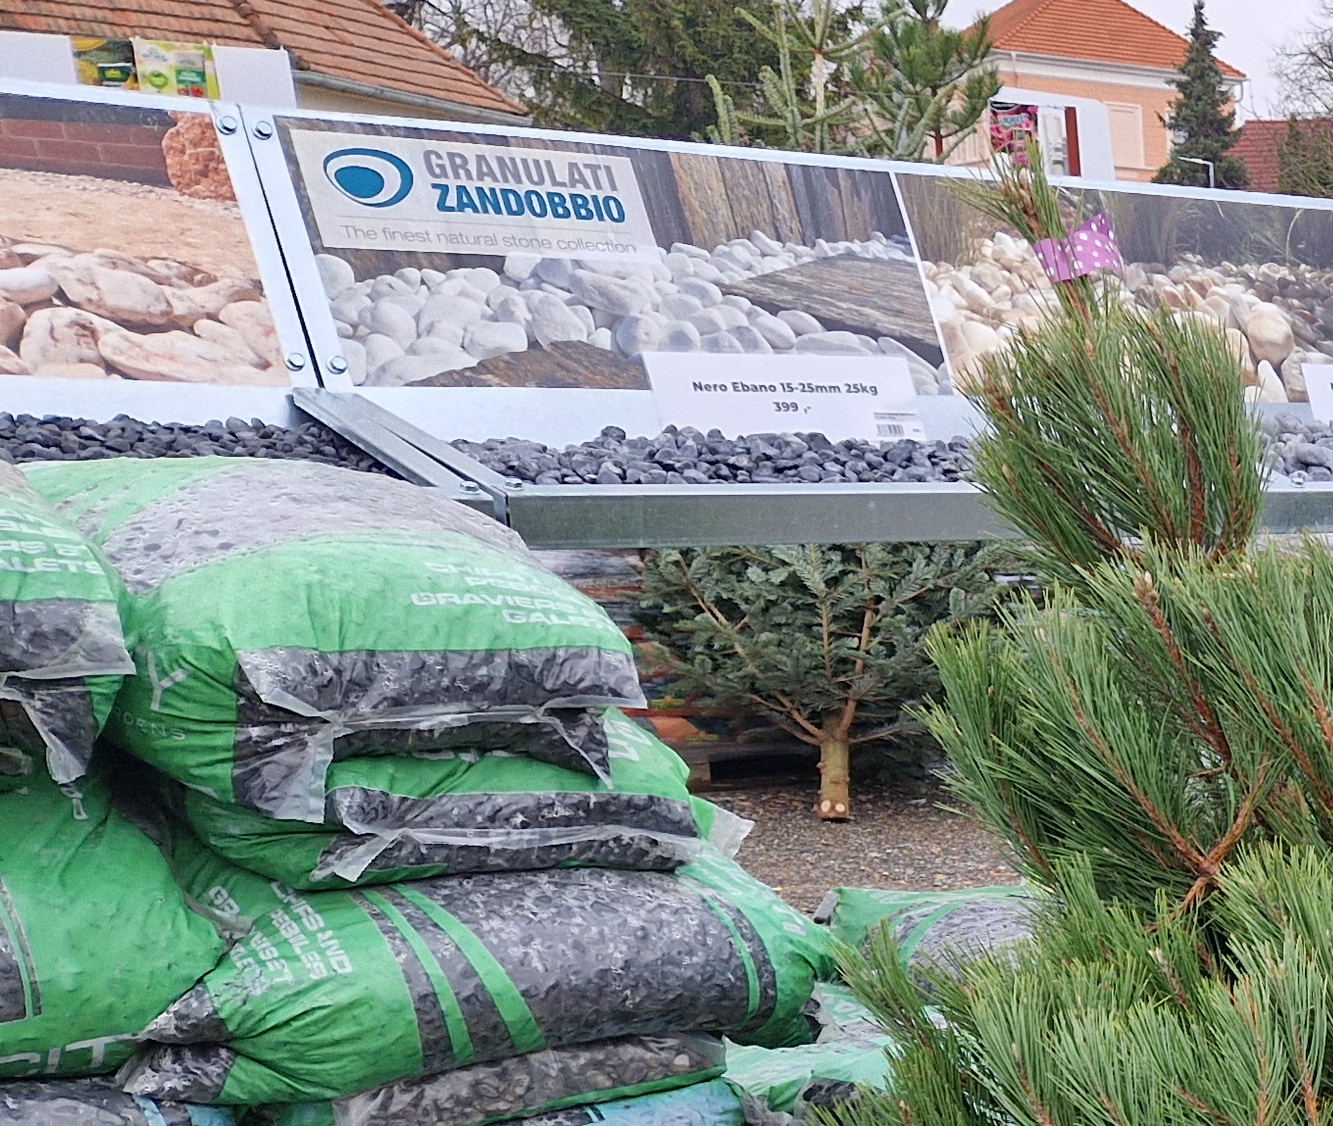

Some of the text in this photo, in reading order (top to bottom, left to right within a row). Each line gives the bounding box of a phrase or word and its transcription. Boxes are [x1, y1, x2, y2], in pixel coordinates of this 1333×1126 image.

[423, 150, 618, 191] GRANULATI
[431, 183, 626, 223] ZANDOBBIO
[340, 224, 637, 254] The finest natural stone collection
[692, 381, 878, 396] Nero Ebano 15-25mm 25kg
[772, 401, 799, 413] 399
